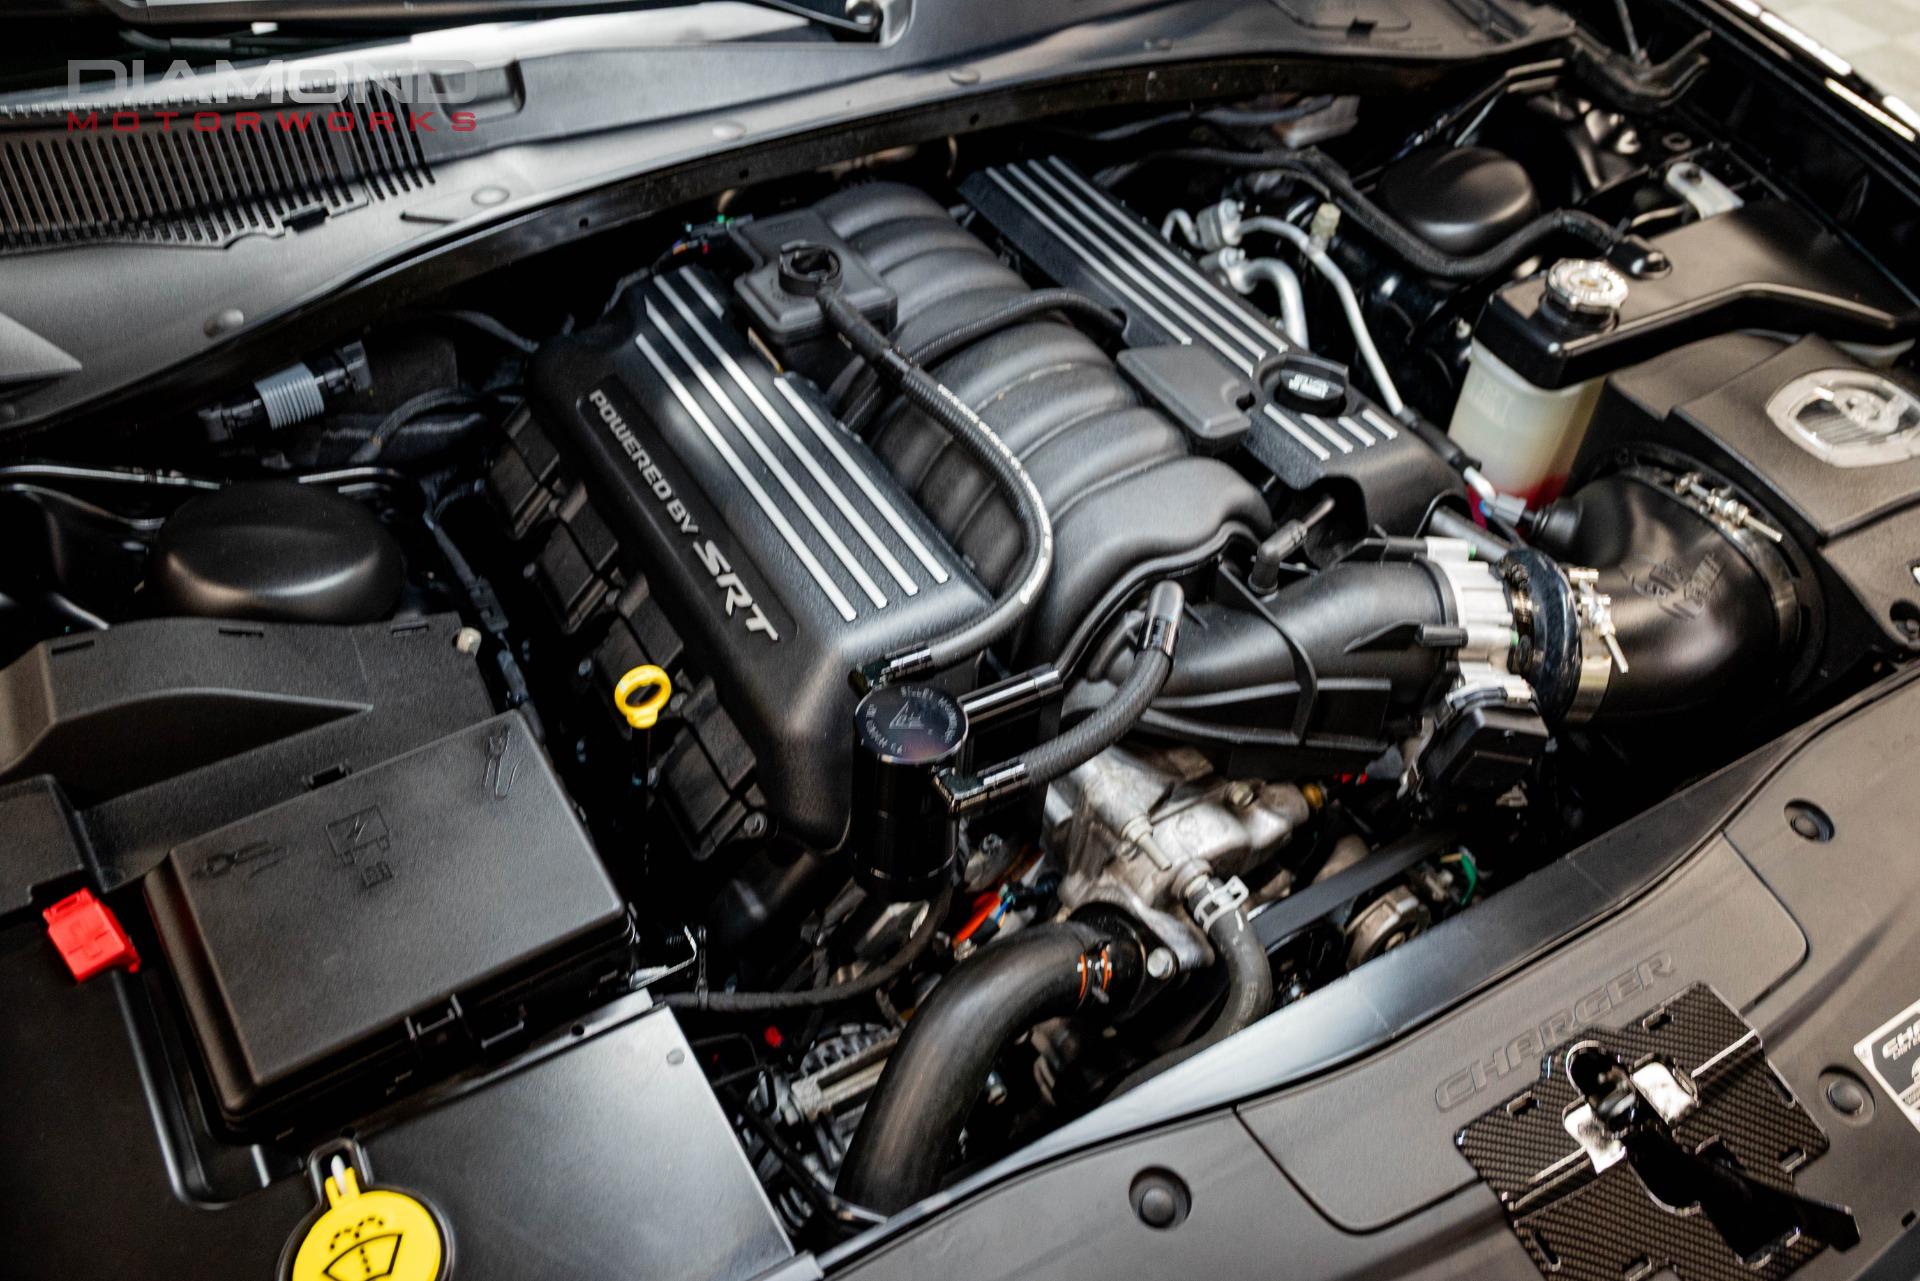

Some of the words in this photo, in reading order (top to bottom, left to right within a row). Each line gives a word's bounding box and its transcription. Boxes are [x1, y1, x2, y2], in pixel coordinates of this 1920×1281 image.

[589, 389, 673, 501] POWERED
[666, 499, 699, 534] BY
[692, 540, 779, 642] SRT
[1434, 949, 1676, 1113] CHARGER
